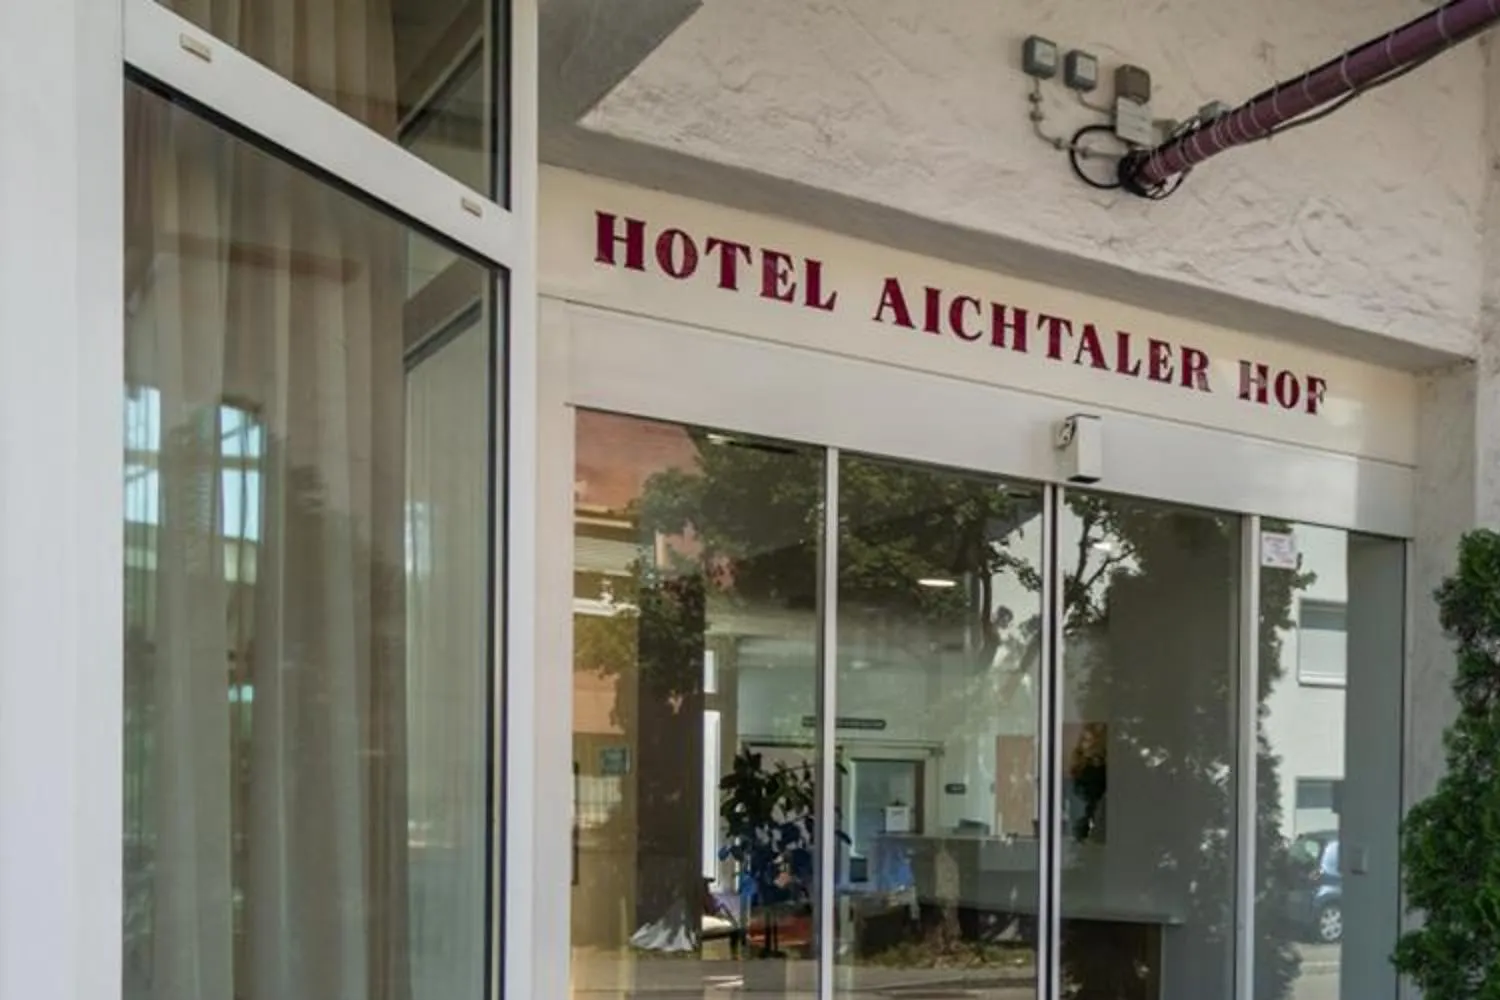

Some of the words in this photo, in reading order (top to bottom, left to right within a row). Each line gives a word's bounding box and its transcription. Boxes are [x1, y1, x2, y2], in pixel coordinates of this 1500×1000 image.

[593, 208, 838, 313] HOTEL
[873, 275, 1212, 393] AICHTALER
[1238, 359, 1328, 415] HOF
